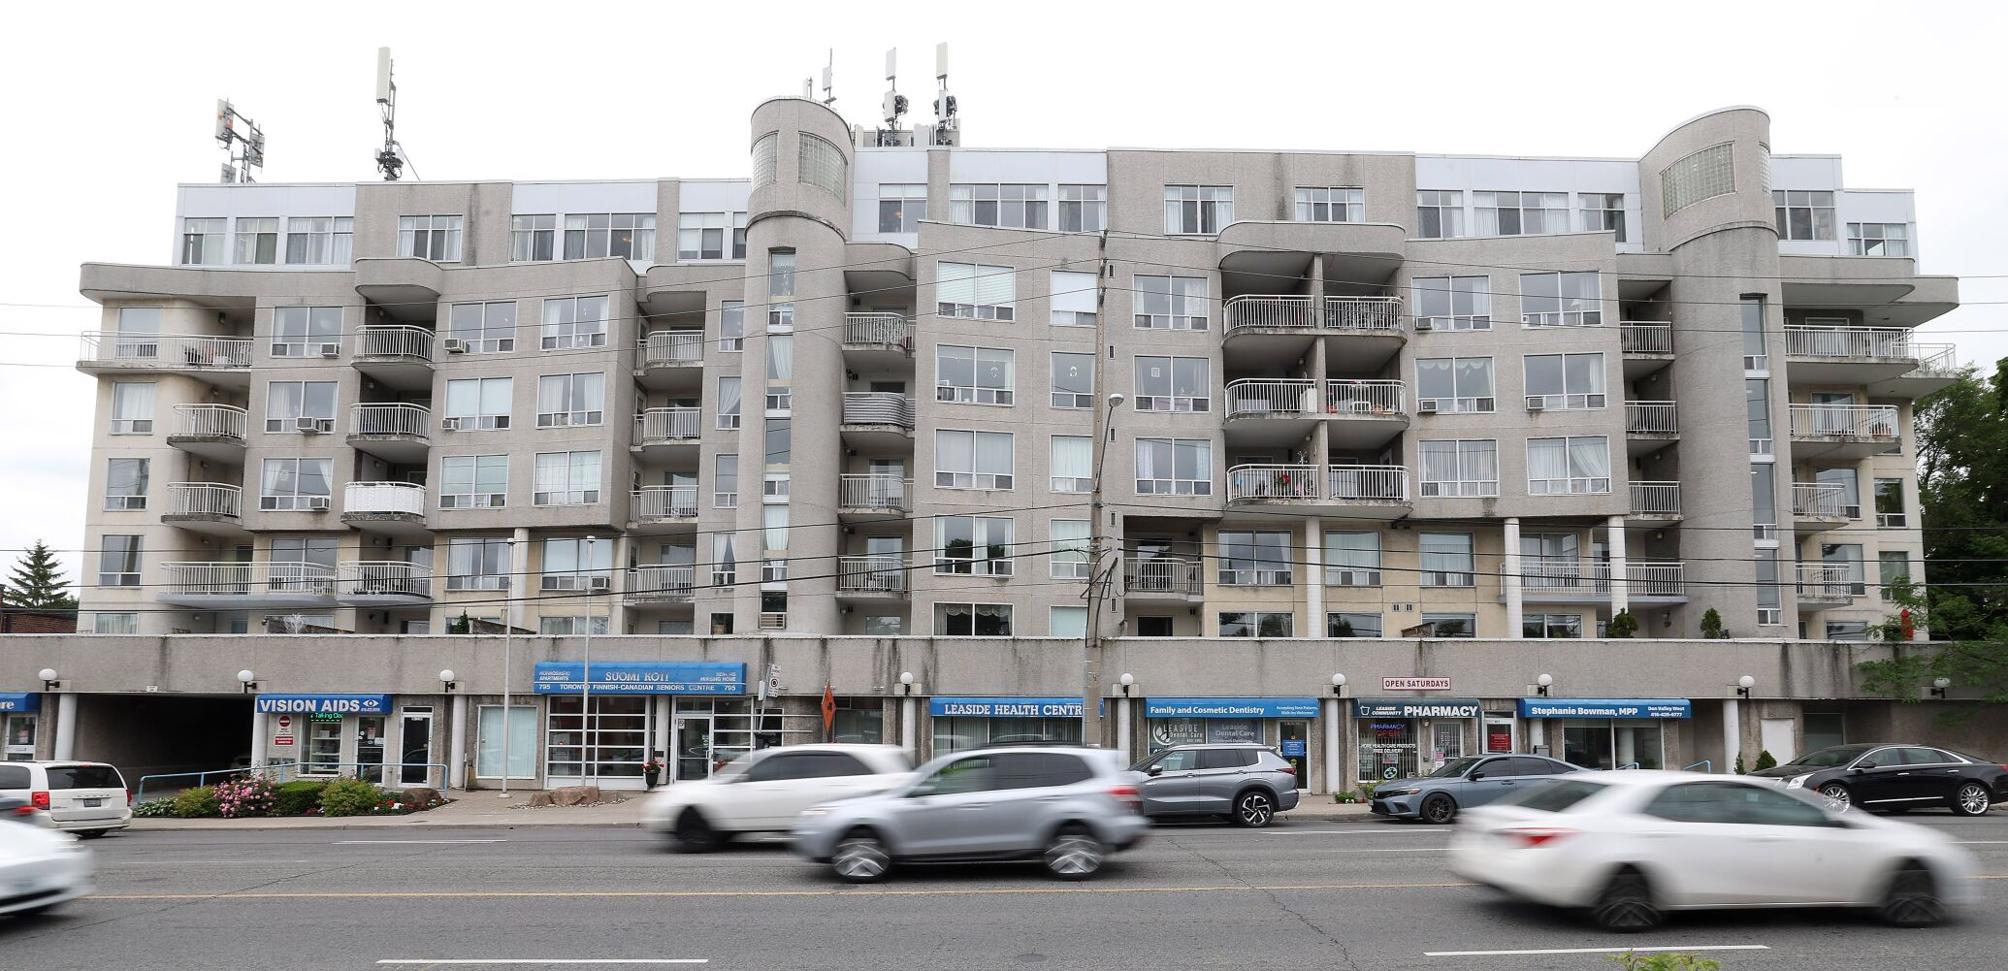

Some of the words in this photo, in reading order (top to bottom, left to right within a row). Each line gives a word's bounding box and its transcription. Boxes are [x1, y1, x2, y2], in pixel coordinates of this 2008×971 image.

[605, 671, 640, 681] SUOMI
[644, 671, 669, 682] KOTI
[1385, 680, 1405, 688] OPEN
[1407, 680, 1449, 688] SATURDAYS
[259, 699, 317, 712] VISION
[321, 699, 360, 712] AIDS
[944, 704, 991, 716] LEASIDE
[994, 704, 1039, 716] HEALTH
[1042, 704, 1083, 716] CENTR
[1403, 705, 1478, 717] PHARMACY
[1150, 706, 1175, 717] Family
[1177, 706, 1192, 714] and
[1193, 706, 1228, 714] Cosmetic
[1230, 706, 1265, 717] Dentistry
[1531, 706, 1576, 718] Stephanie
[1578, 707, 1617, 717] Bowman,
[1164, 723, 1199, 732] LEASIDE
